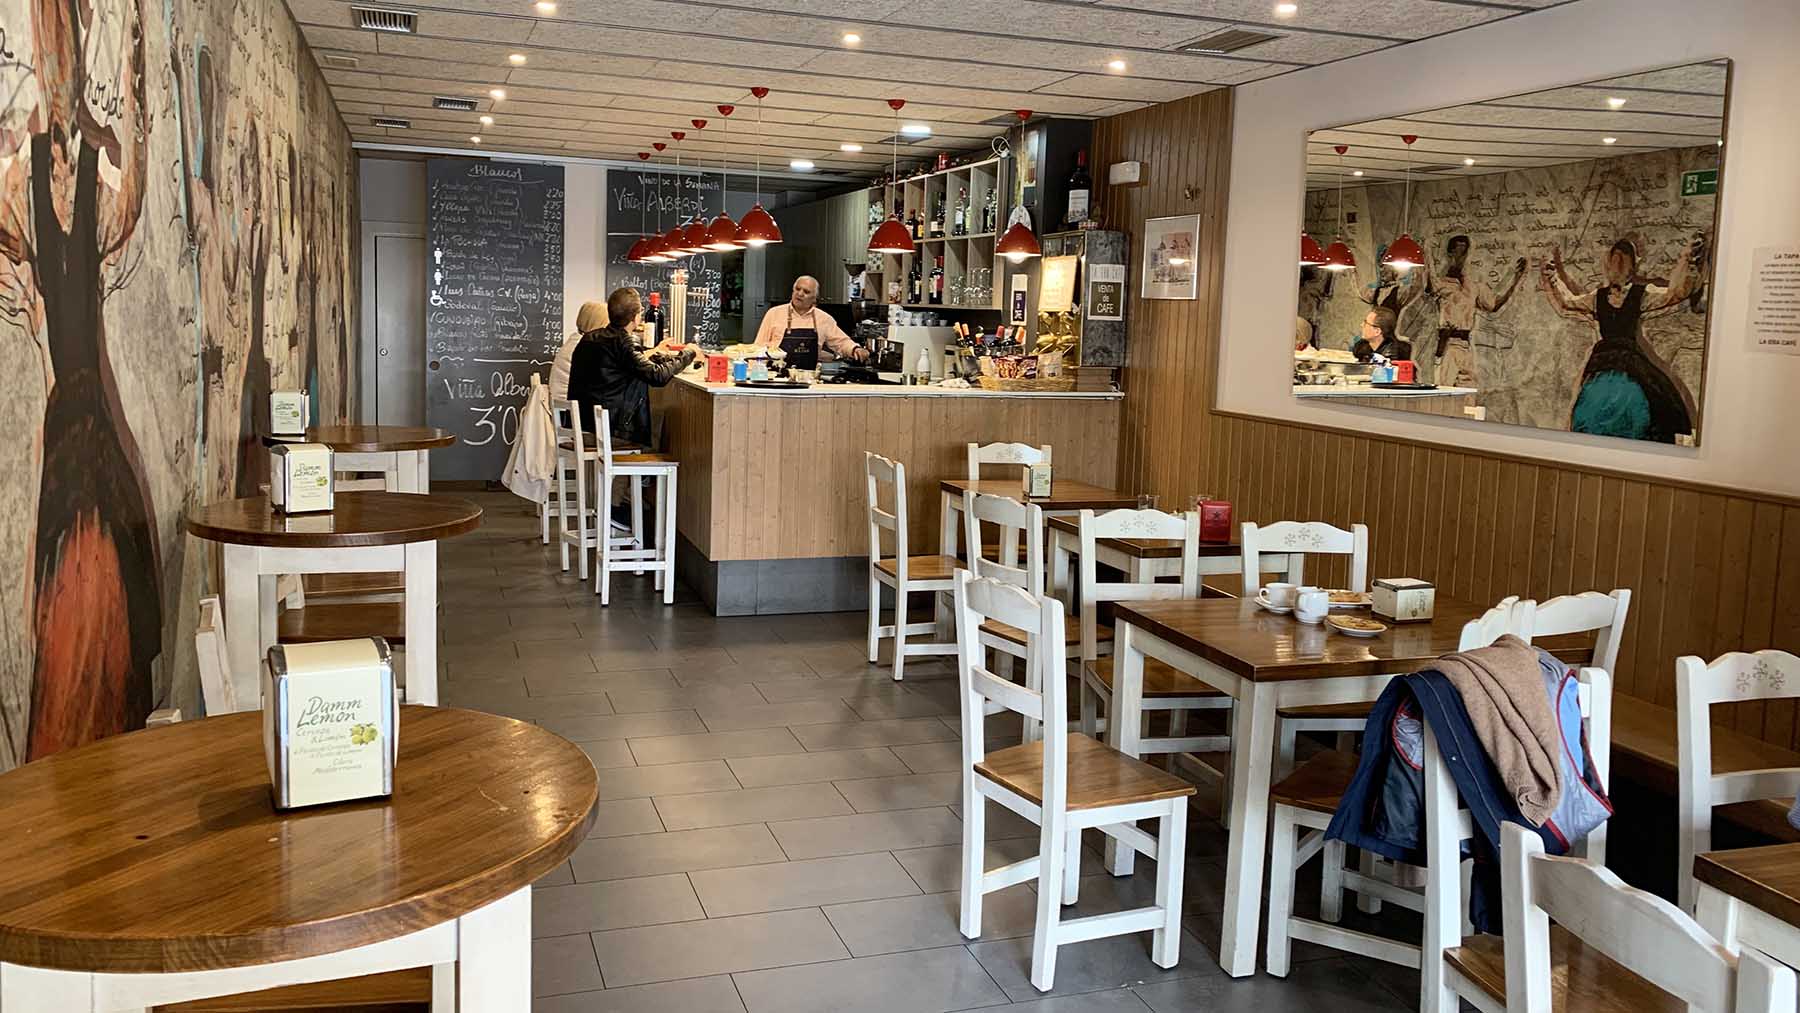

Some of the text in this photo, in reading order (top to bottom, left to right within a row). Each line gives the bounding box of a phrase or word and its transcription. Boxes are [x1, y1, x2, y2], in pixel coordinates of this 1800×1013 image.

[463, 405, 525, 446] 3'0
[306, 695, 363, 716] Damm
[297, 709, 356, 728] Lemon
